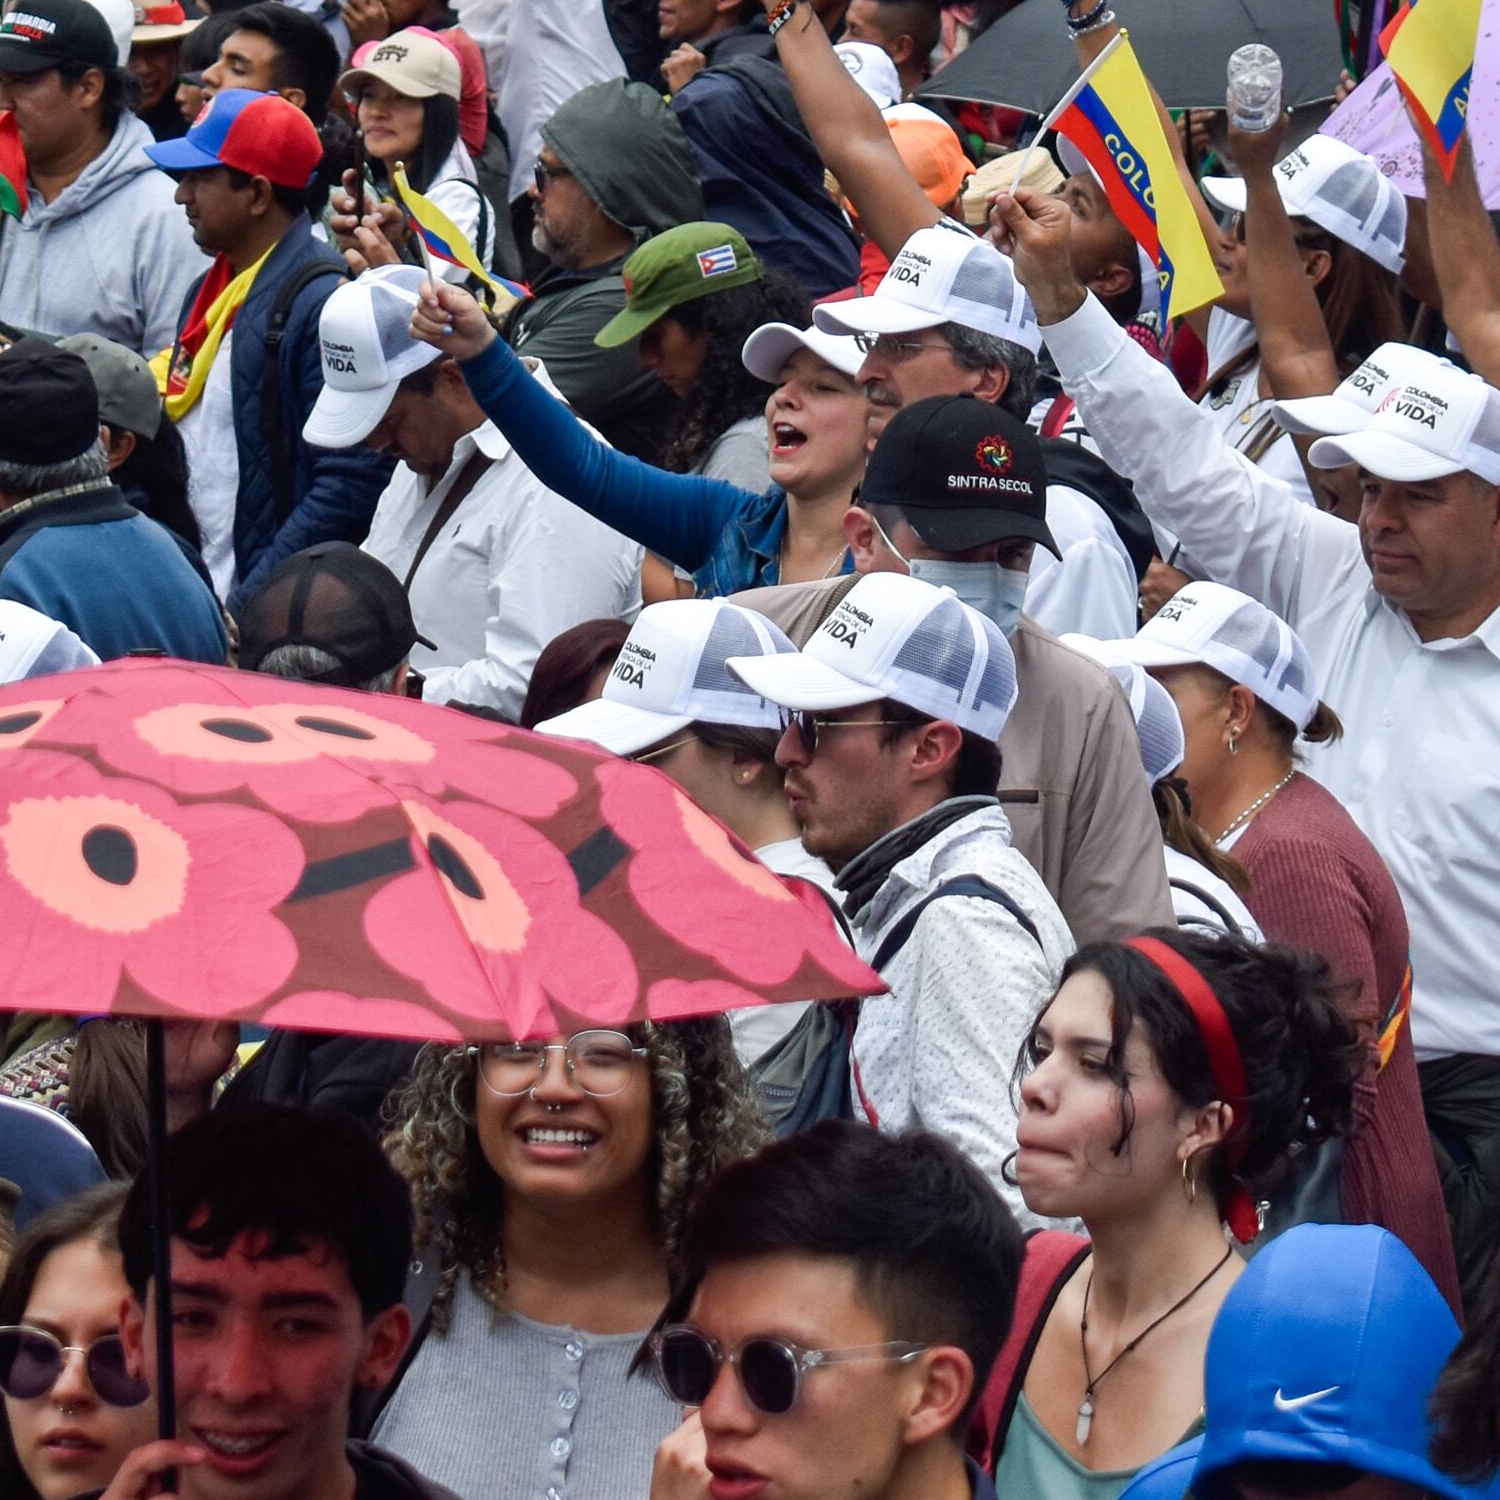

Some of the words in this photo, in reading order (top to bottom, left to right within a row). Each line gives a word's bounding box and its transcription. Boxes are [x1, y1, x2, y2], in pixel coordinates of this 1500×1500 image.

[889, 265, 920, 287] VIDA
[324, 354, 357, 374] VIDA
[1405, 386, 1449, 410] COLOMBIA
[1395, 401, 1436, 430] VIDA
[947, 474, 1034, 495] SINTRASECOL
[822, 617, 858, 649] VIDA
[613, 660, 644, 690] VIDA
